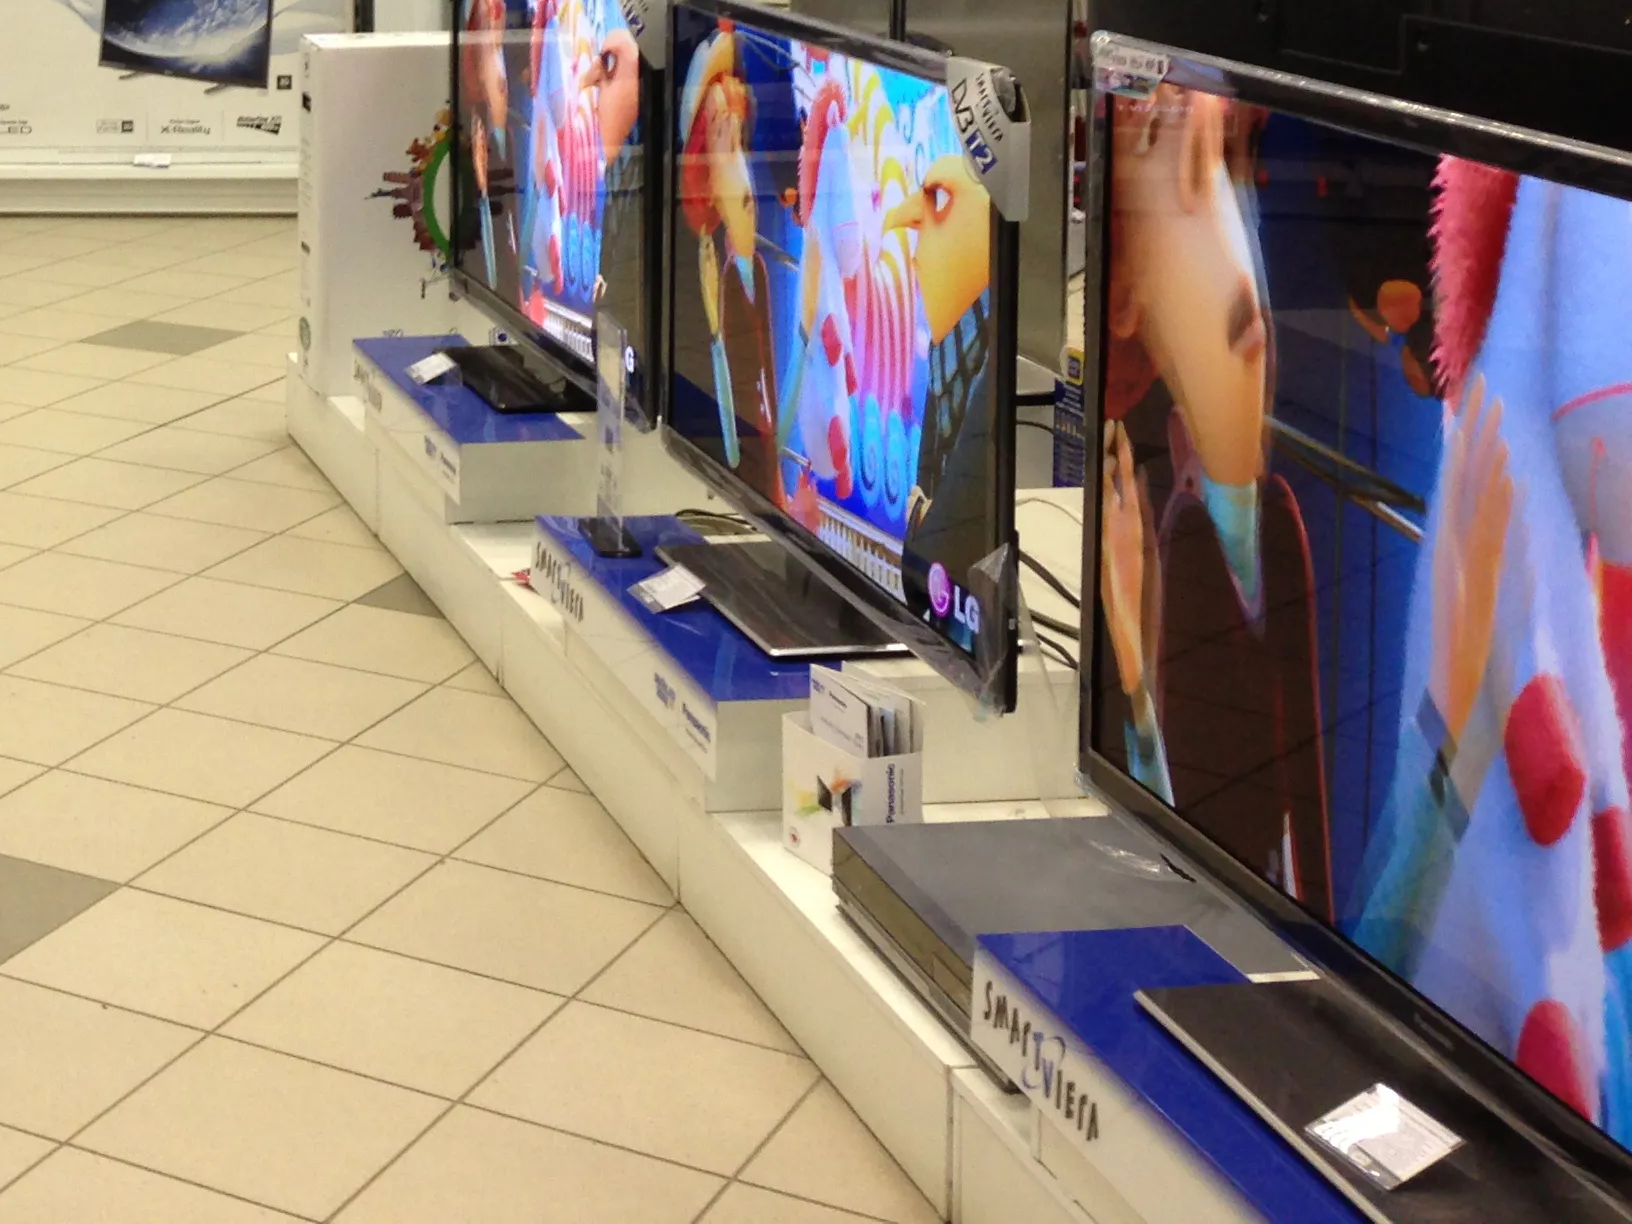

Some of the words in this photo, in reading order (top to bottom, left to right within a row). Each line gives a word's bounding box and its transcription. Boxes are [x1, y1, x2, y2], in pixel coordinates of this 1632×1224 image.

[951, 77, 975, 134] DVB
[966, 129, 998, 174] T2
[954, 583, 980, 635] LG
[885, 763, 896, 824] Panasonic
